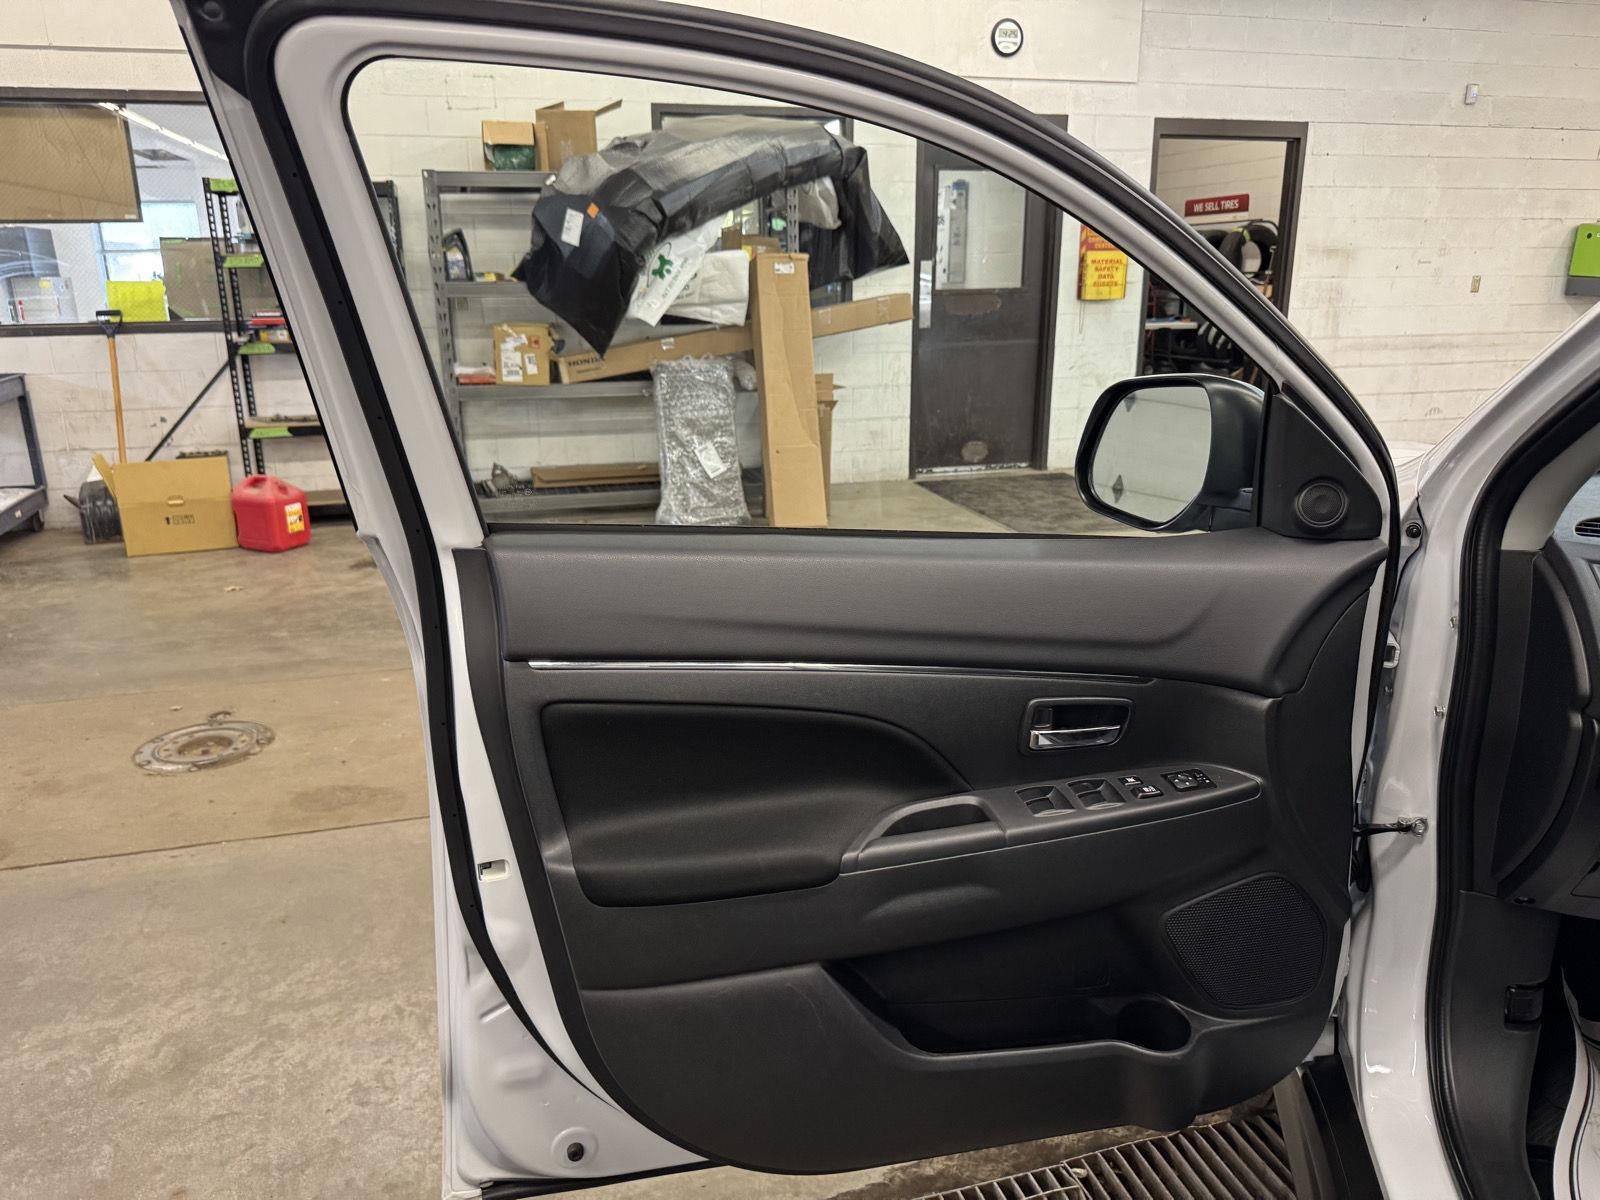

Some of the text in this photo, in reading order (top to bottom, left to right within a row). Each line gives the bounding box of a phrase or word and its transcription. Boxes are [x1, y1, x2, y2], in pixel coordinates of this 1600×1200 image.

[1194, 199, 1240, 212] WE SELL TIRES
